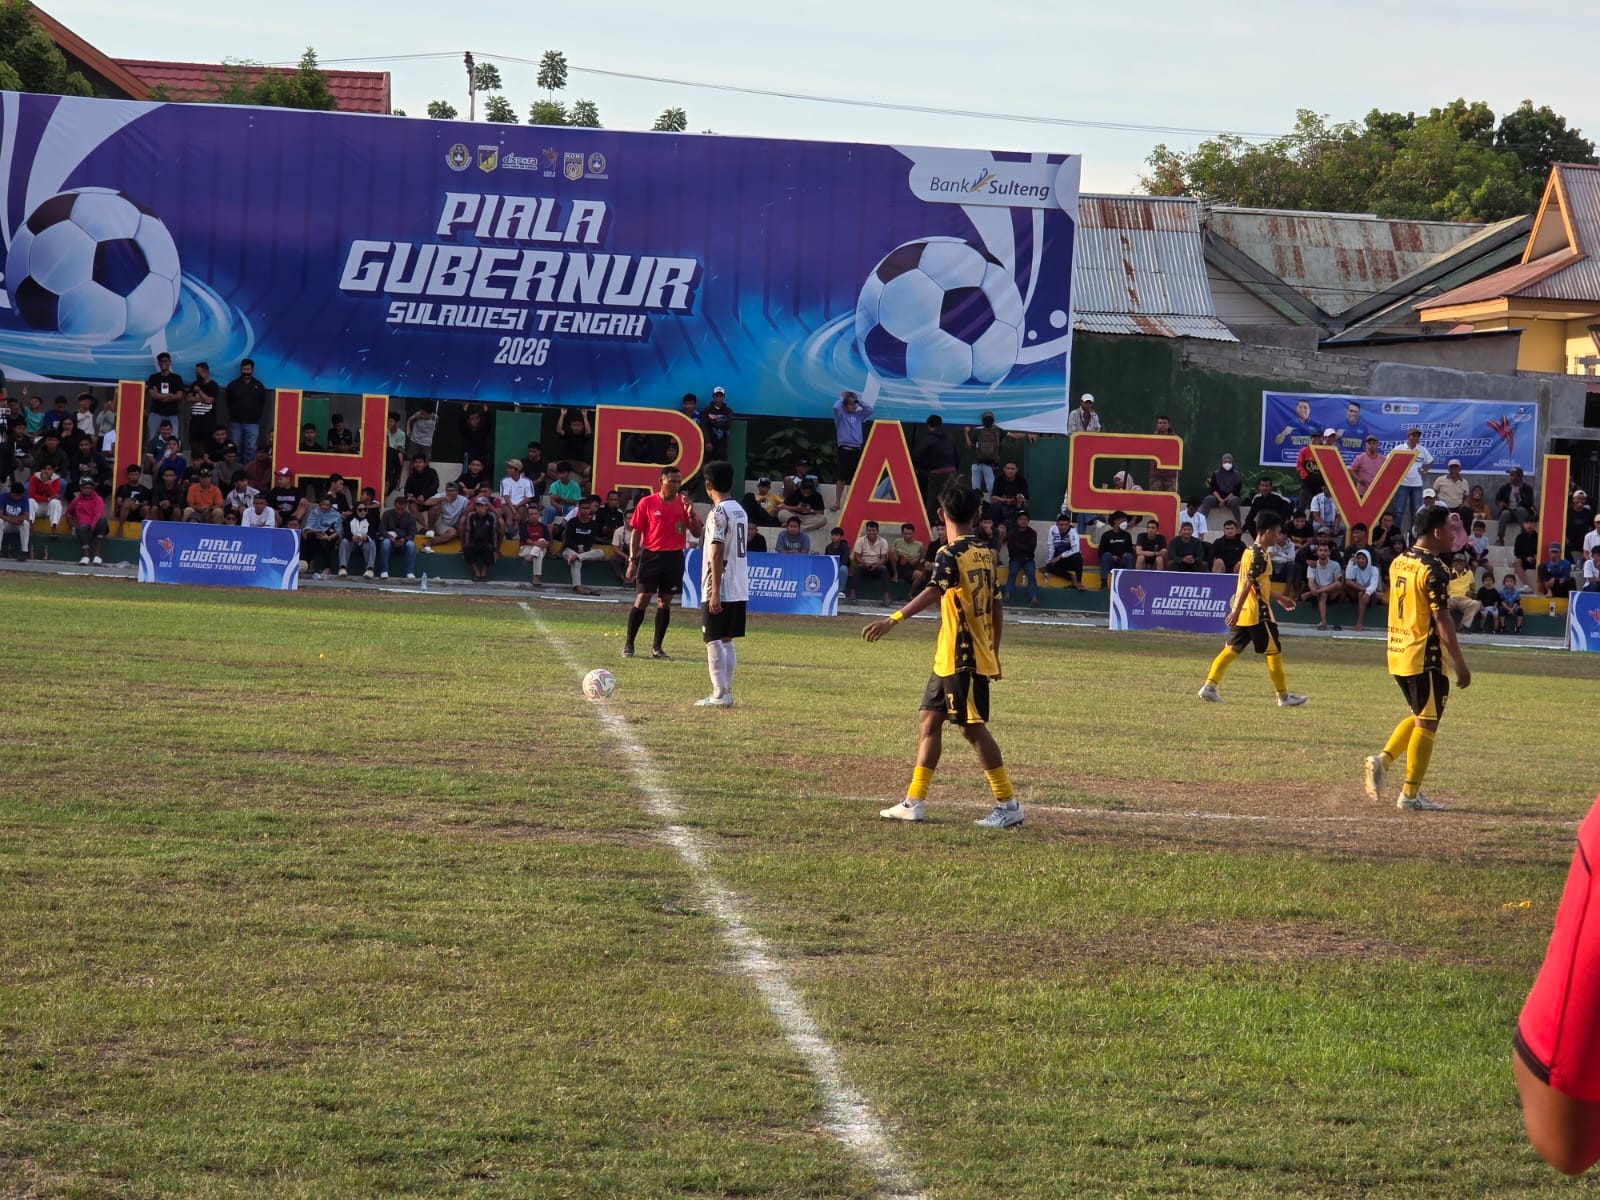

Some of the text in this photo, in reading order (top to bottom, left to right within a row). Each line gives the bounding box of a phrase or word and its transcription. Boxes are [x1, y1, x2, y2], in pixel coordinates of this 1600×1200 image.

[930, 177, 1050, 200] Bank Sulteng
[434, 191, 608, 245] PIALA
[338, 239, 699, 310] GUBERNUR
[385, 301, 648, 337] SULAWESI TENGAH
[493, 336, 551, 367] 2026
[198, 538, 242, 551] PIALA
[736, 523, 746, 558] 8
[180, 550, 257, 565] GUBERNUR
[747, 579, 798, 592] ERNUR
[1169, 586, 1212, 598] PIALA
[1395, 575, 1407, 619] 7
[1151, 597, 1227, 611] GUBERNUR
